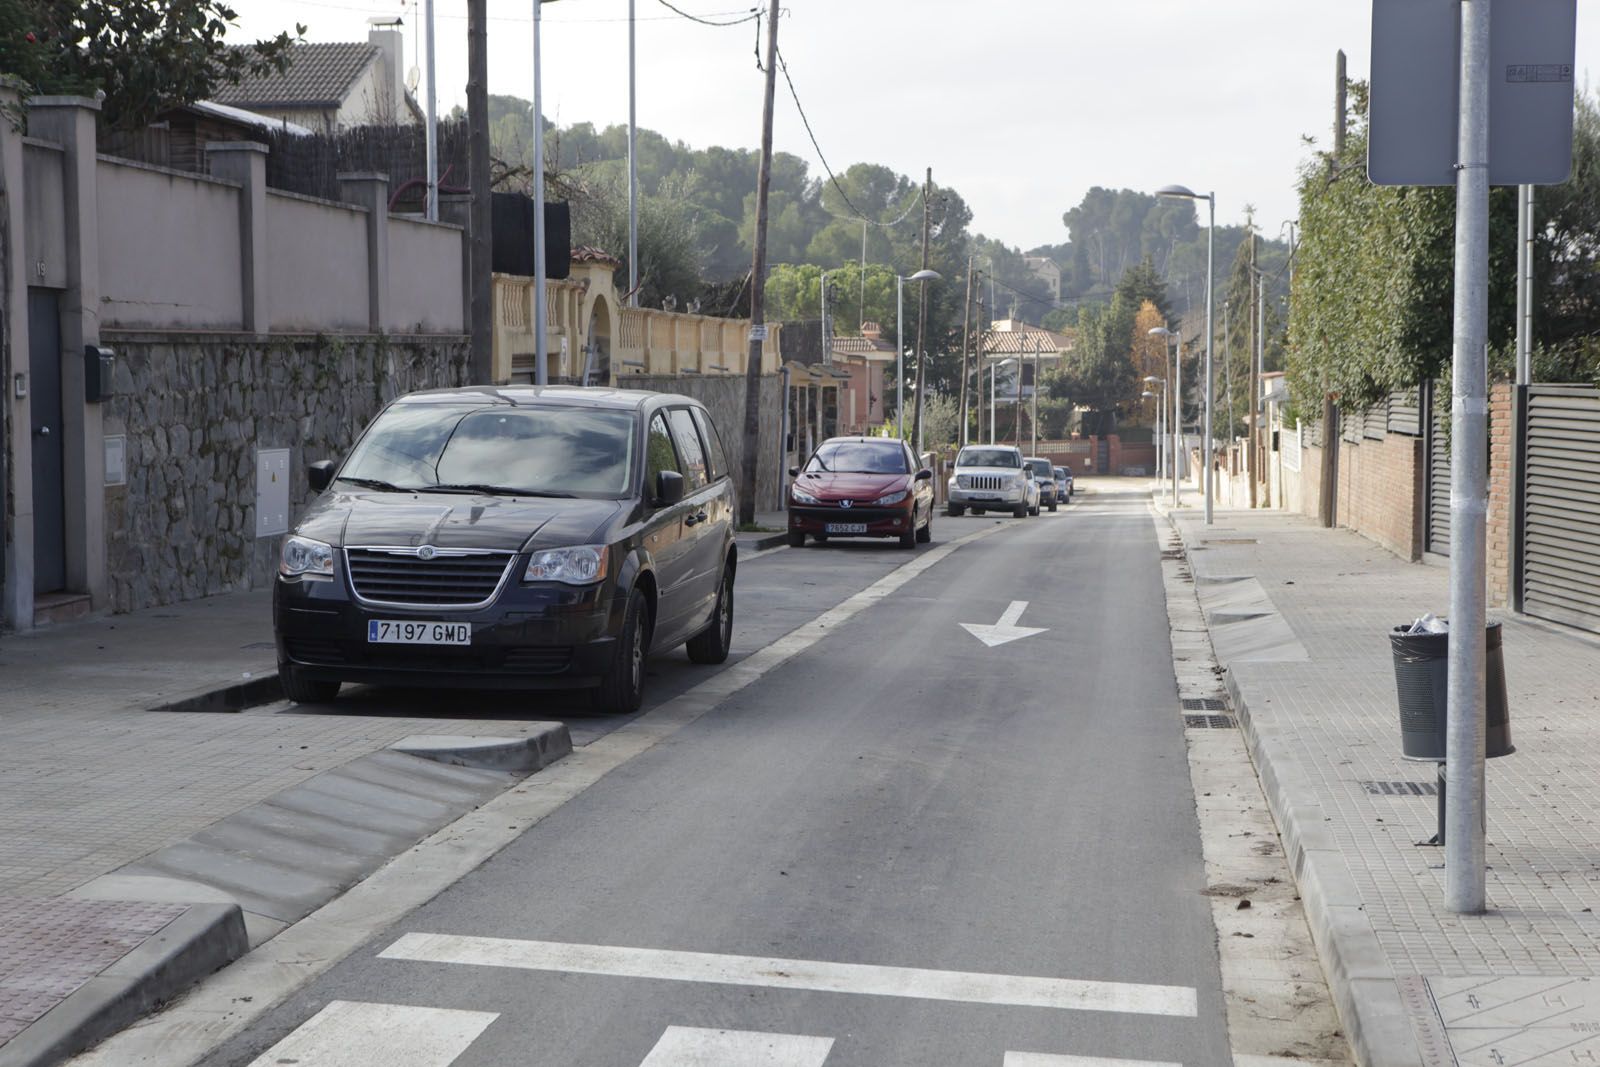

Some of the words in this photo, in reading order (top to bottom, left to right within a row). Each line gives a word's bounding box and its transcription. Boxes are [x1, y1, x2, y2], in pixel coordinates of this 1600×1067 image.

[36, 261, 46, 277] 19
[380, 623, 427, 641] 7197
[432, 624, 467, 642] GMD
